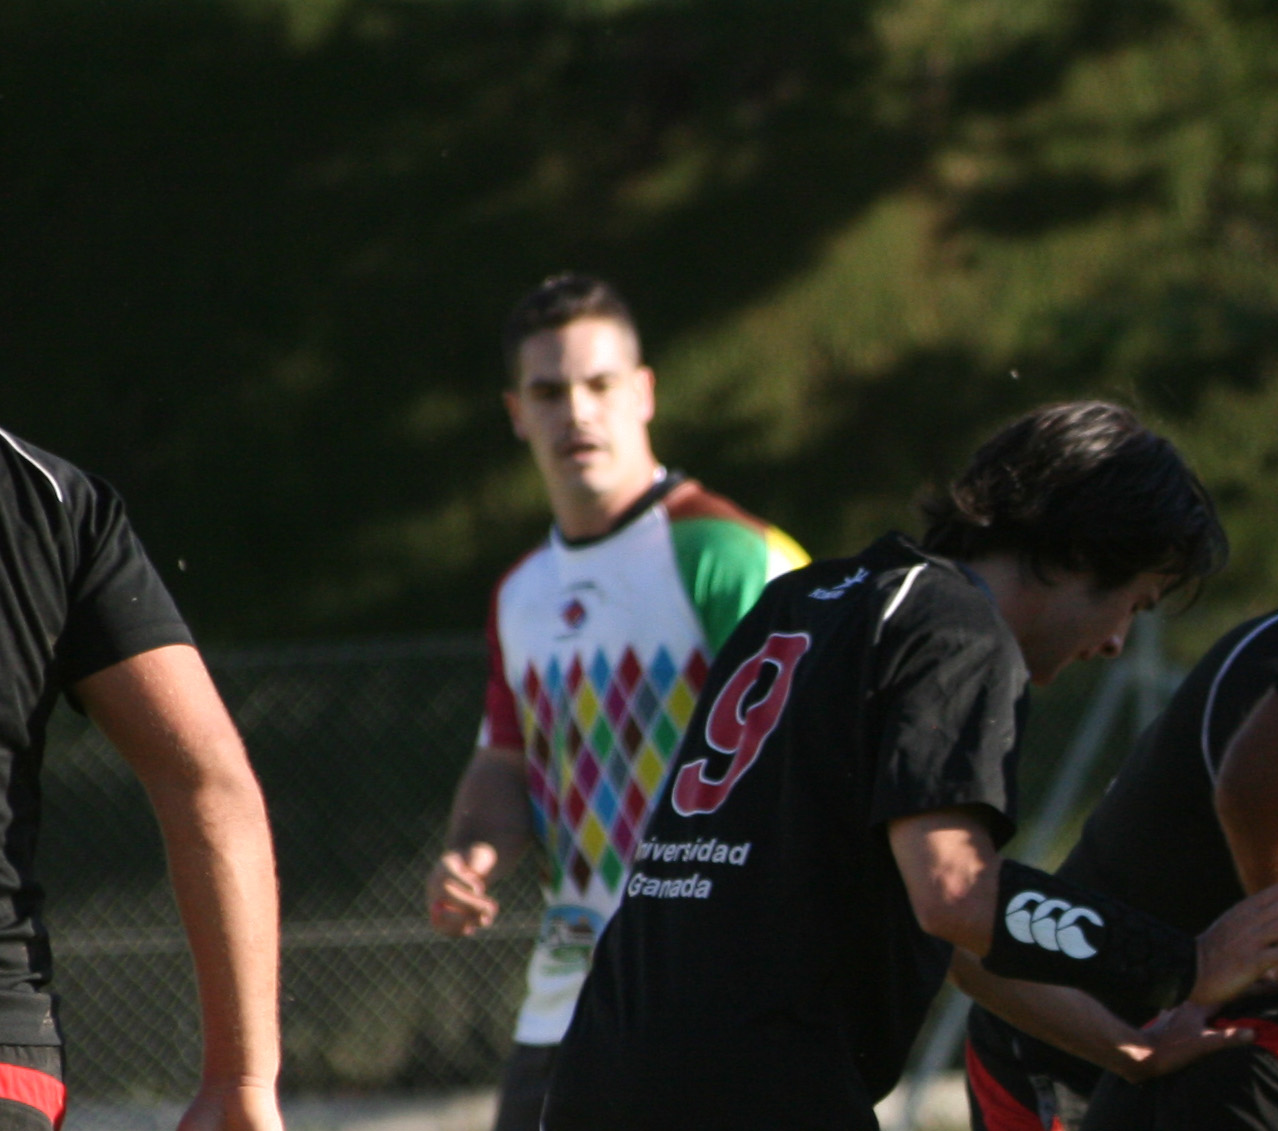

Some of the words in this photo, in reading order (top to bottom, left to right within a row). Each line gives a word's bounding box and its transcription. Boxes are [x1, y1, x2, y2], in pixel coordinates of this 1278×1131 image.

[671, 631, 812, 817] 9
[635, 837, 752, 866] niversidad
[627, 872, 713, 898] Granada
